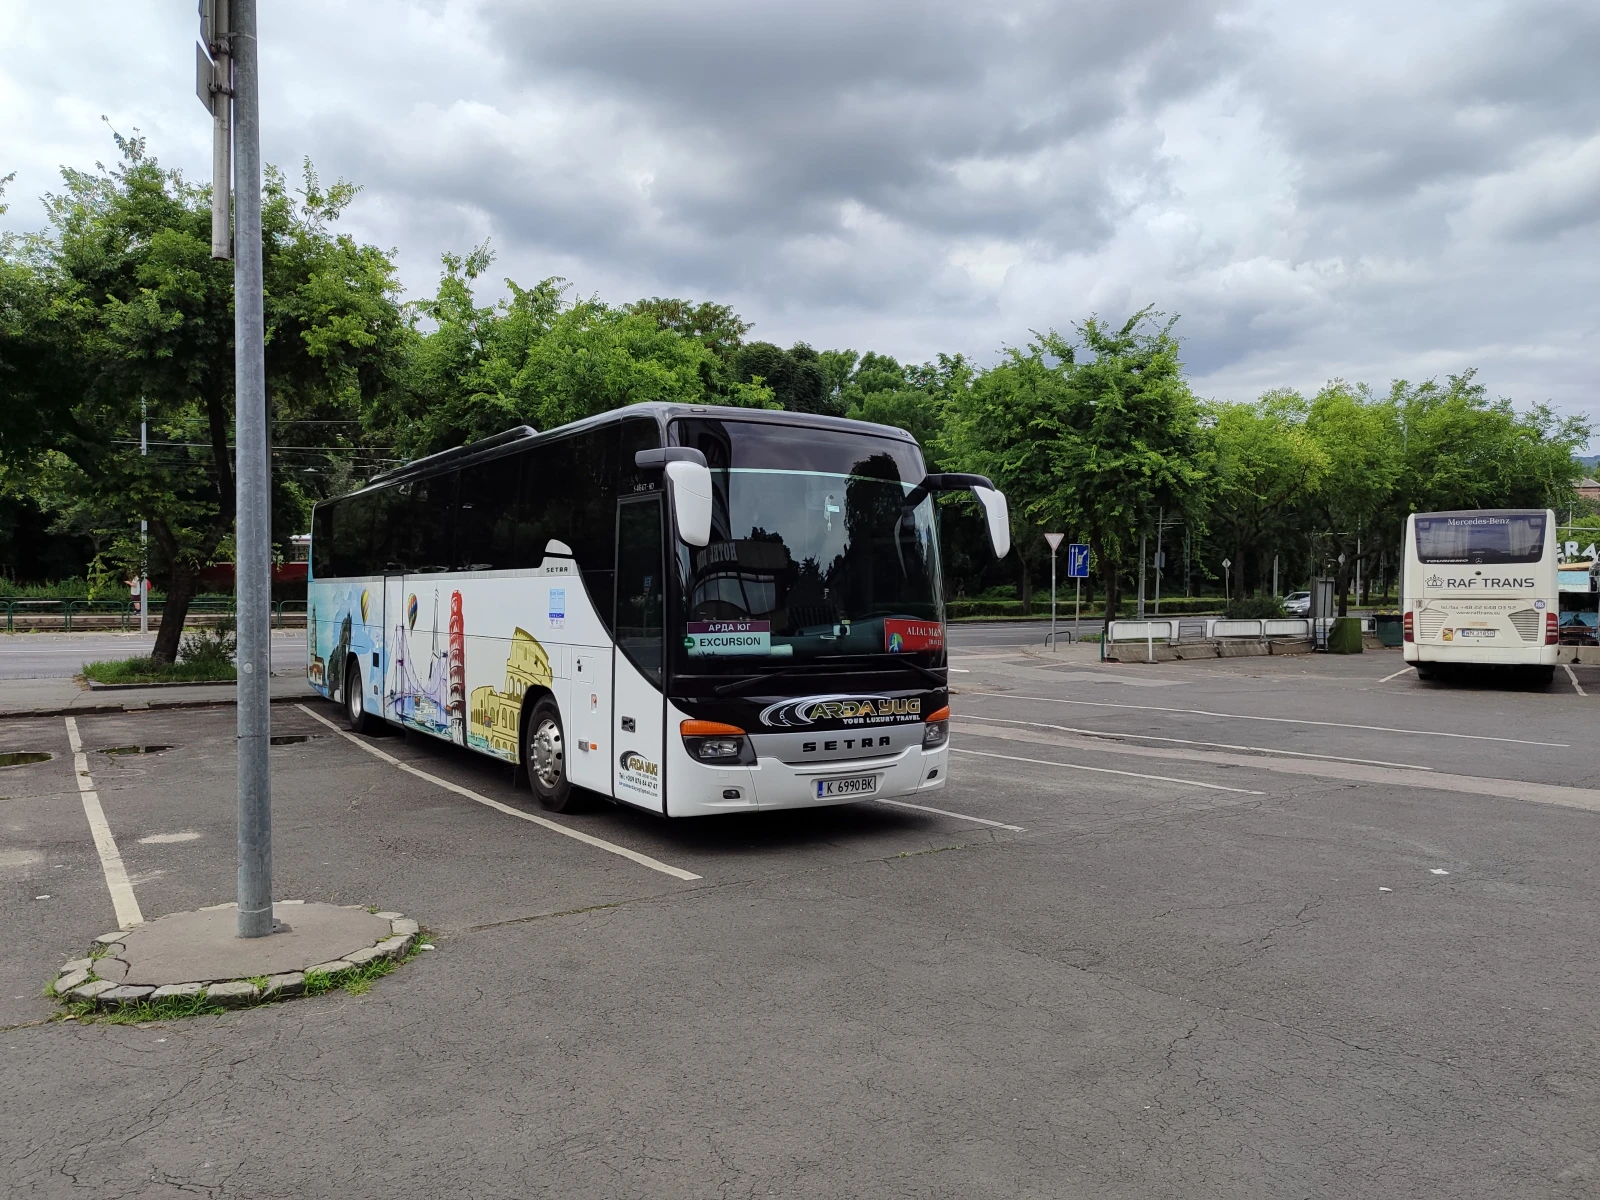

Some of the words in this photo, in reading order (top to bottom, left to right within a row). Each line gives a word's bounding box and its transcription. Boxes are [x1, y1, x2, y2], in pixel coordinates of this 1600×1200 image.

[1447, 578, 1477, 588] RAF
[1482, 578, 1535, 588] TRANS
[708, 624, 734, 632] АРДА
[907, 626, 927, 636] ALIAL
[700, 637, 760, 647] EXCURSION
[810, 700, 877, 719] ARDA
[879, 698, 920, 715] YUG
[802, 736, 890, 752] SETRA
[629, 757, 645, 772] ARDA
[827, 782, 833, 794] K
